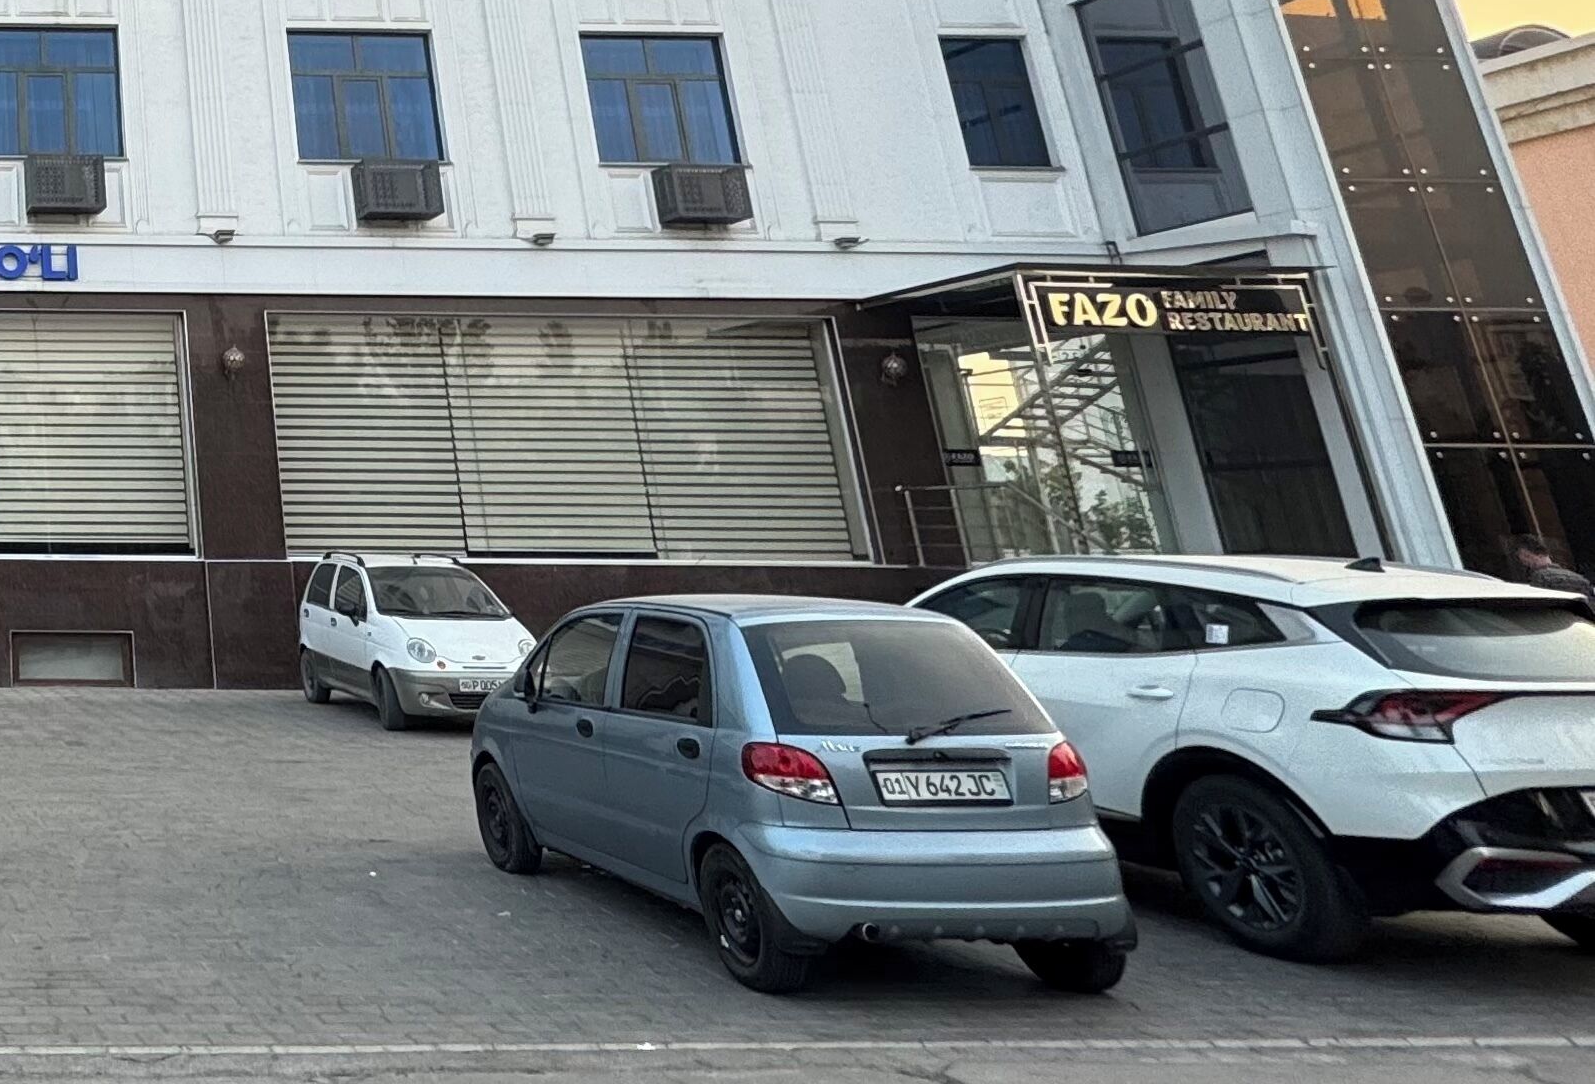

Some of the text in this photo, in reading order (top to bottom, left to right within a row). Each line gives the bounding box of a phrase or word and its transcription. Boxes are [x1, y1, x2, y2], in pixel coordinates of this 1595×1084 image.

[1047, 291, 1158, 328] FAZO
[1160, 290, 1237, 310] FAMILY
[1167, 312, 1310, 333] RESTAURANT
[883, 774, 996, 797] 01 Y 642 JC
